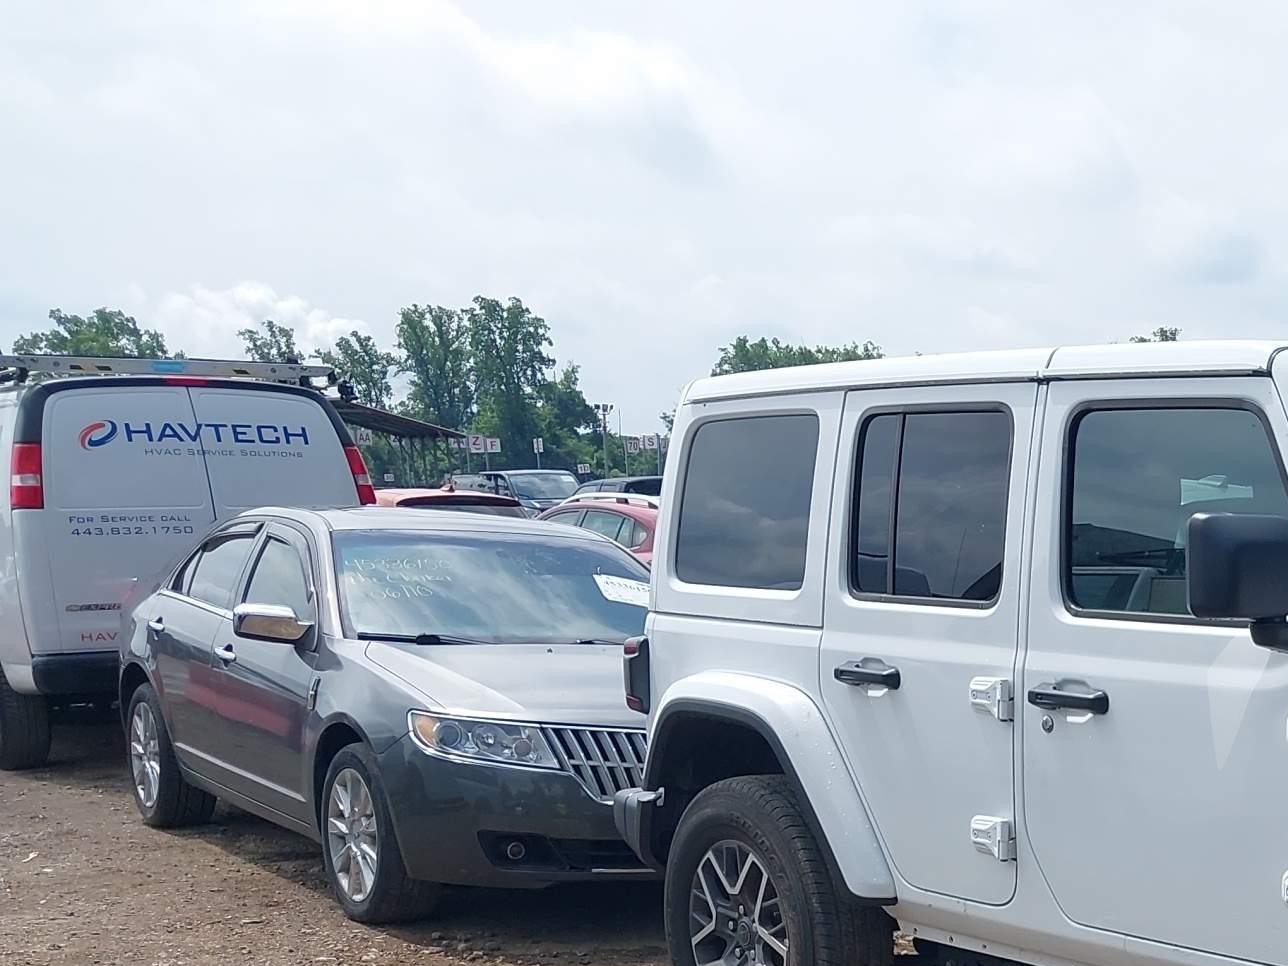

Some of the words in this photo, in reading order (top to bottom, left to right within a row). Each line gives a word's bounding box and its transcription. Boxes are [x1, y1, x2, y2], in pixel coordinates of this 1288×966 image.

[124, 422, 309, 446] HAVTECH
[490, 440, 497, 450] F
[628, 441, 637, 451] 70
[647, 437, 655, 447] S
[144, 448, 182, 456] HVAC
[69, 515, 94, 524] FOR
[71, 526, 194, 536] 443.832.1750
[81, 631, 120, 641] HAV
